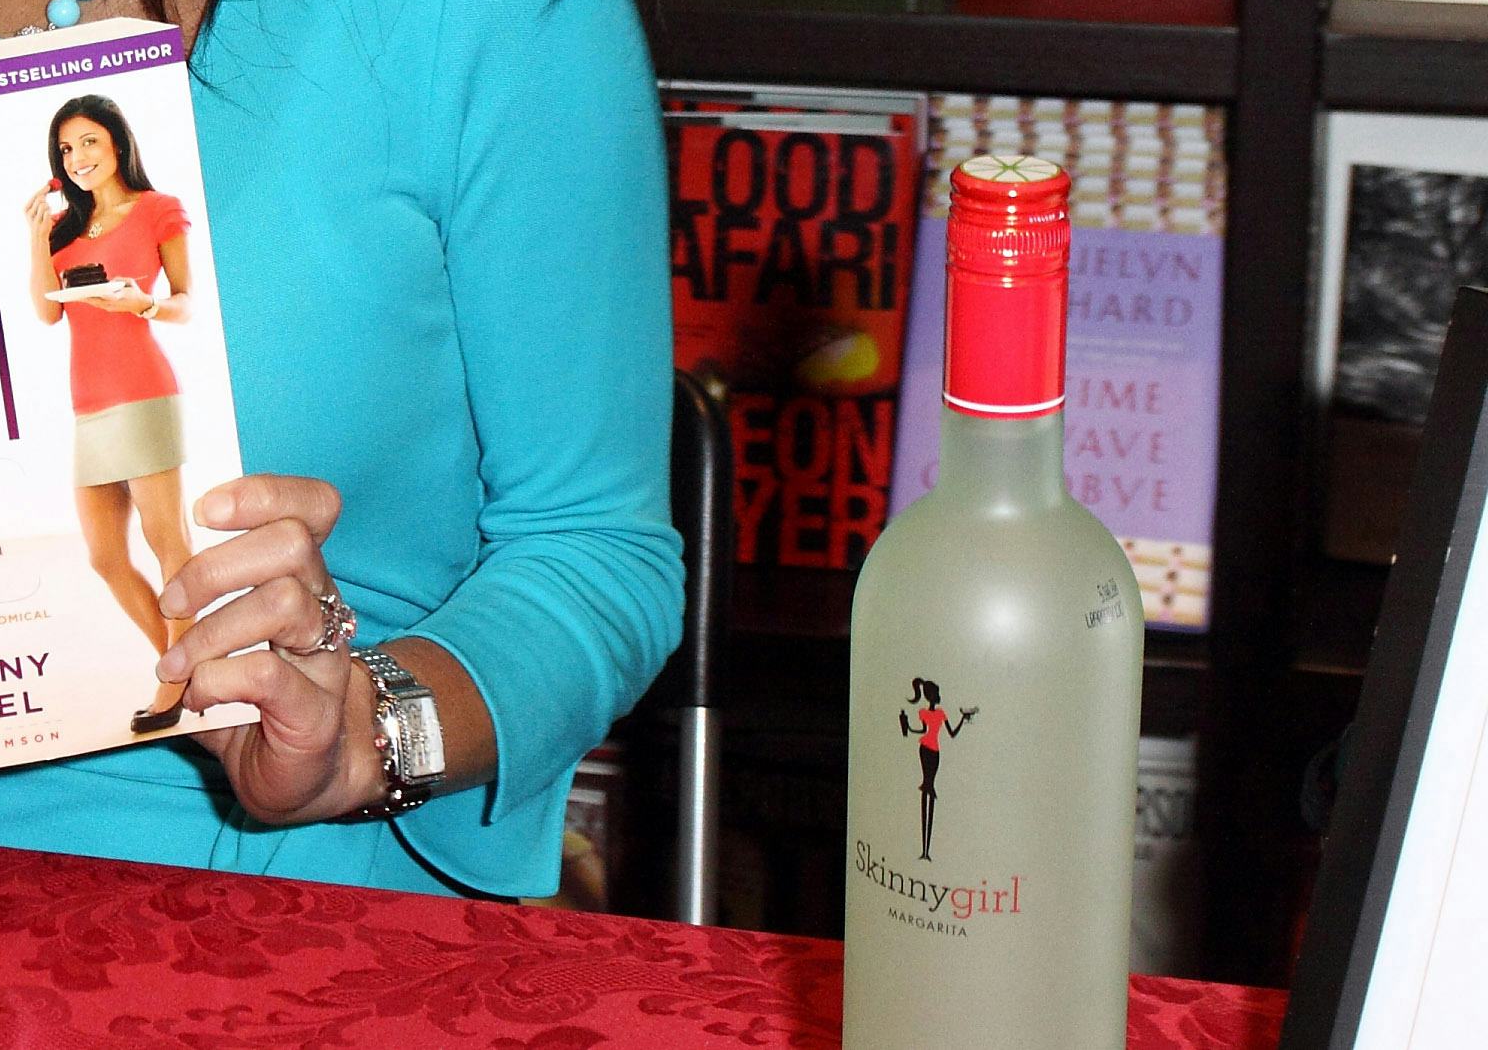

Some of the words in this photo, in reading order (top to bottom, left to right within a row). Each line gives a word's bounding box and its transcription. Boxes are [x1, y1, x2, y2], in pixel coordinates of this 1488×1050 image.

[100, 43, 173, 69] AUTHOR
[1067, 378, 1164, 416] IME
[1068, 425, 1166, 465] AVE
[855, 839, 1024, 920] Skinnygirl
[888, 907, 968, 938] MARGARITA
